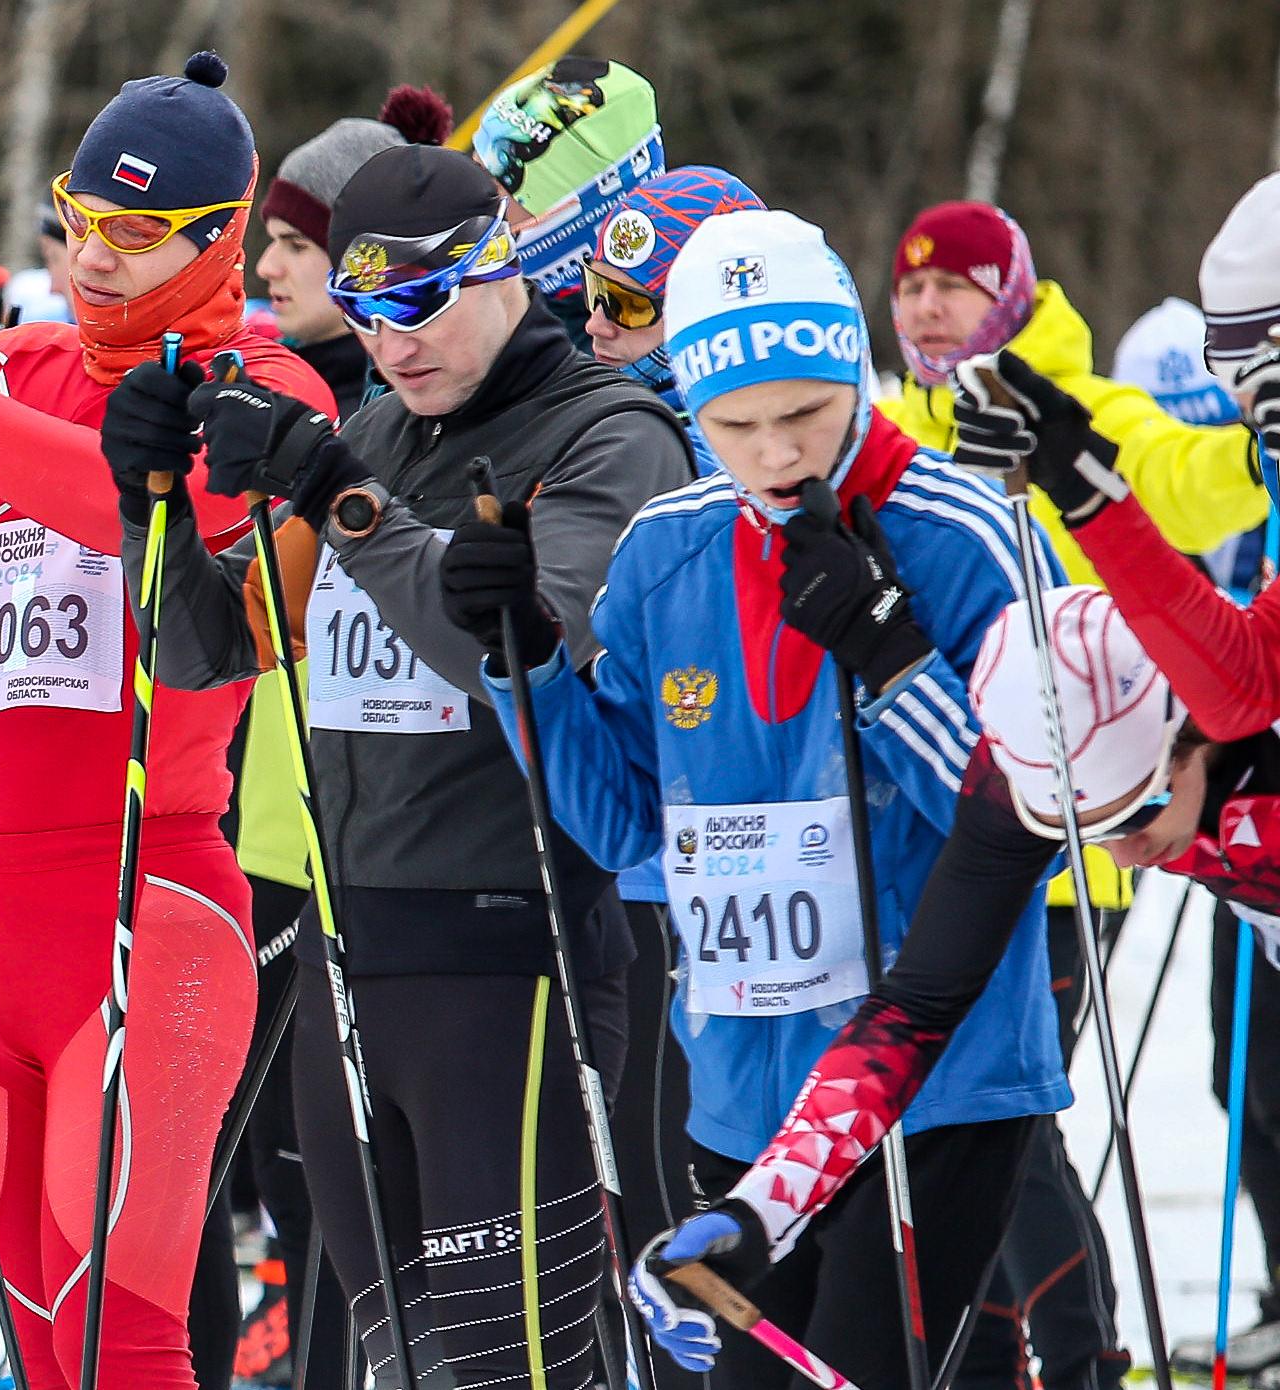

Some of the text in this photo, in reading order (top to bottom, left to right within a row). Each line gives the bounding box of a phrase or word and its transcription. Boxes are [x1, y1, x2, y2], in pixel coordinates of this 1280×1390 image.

[7, 675, 90, 690] НОВОСИБИРСКАЯ
[6, 687, 51, 701] ОБЛАСТЬ
[705, 814, 768, 833] ЛЫЖНЯ
[705, 832, 766, 851] РОССИИ
[705, 855, 768, 878] 2024
[690, 890, 823, 963] 2410
[329, 964, 351, 1027] RACE
